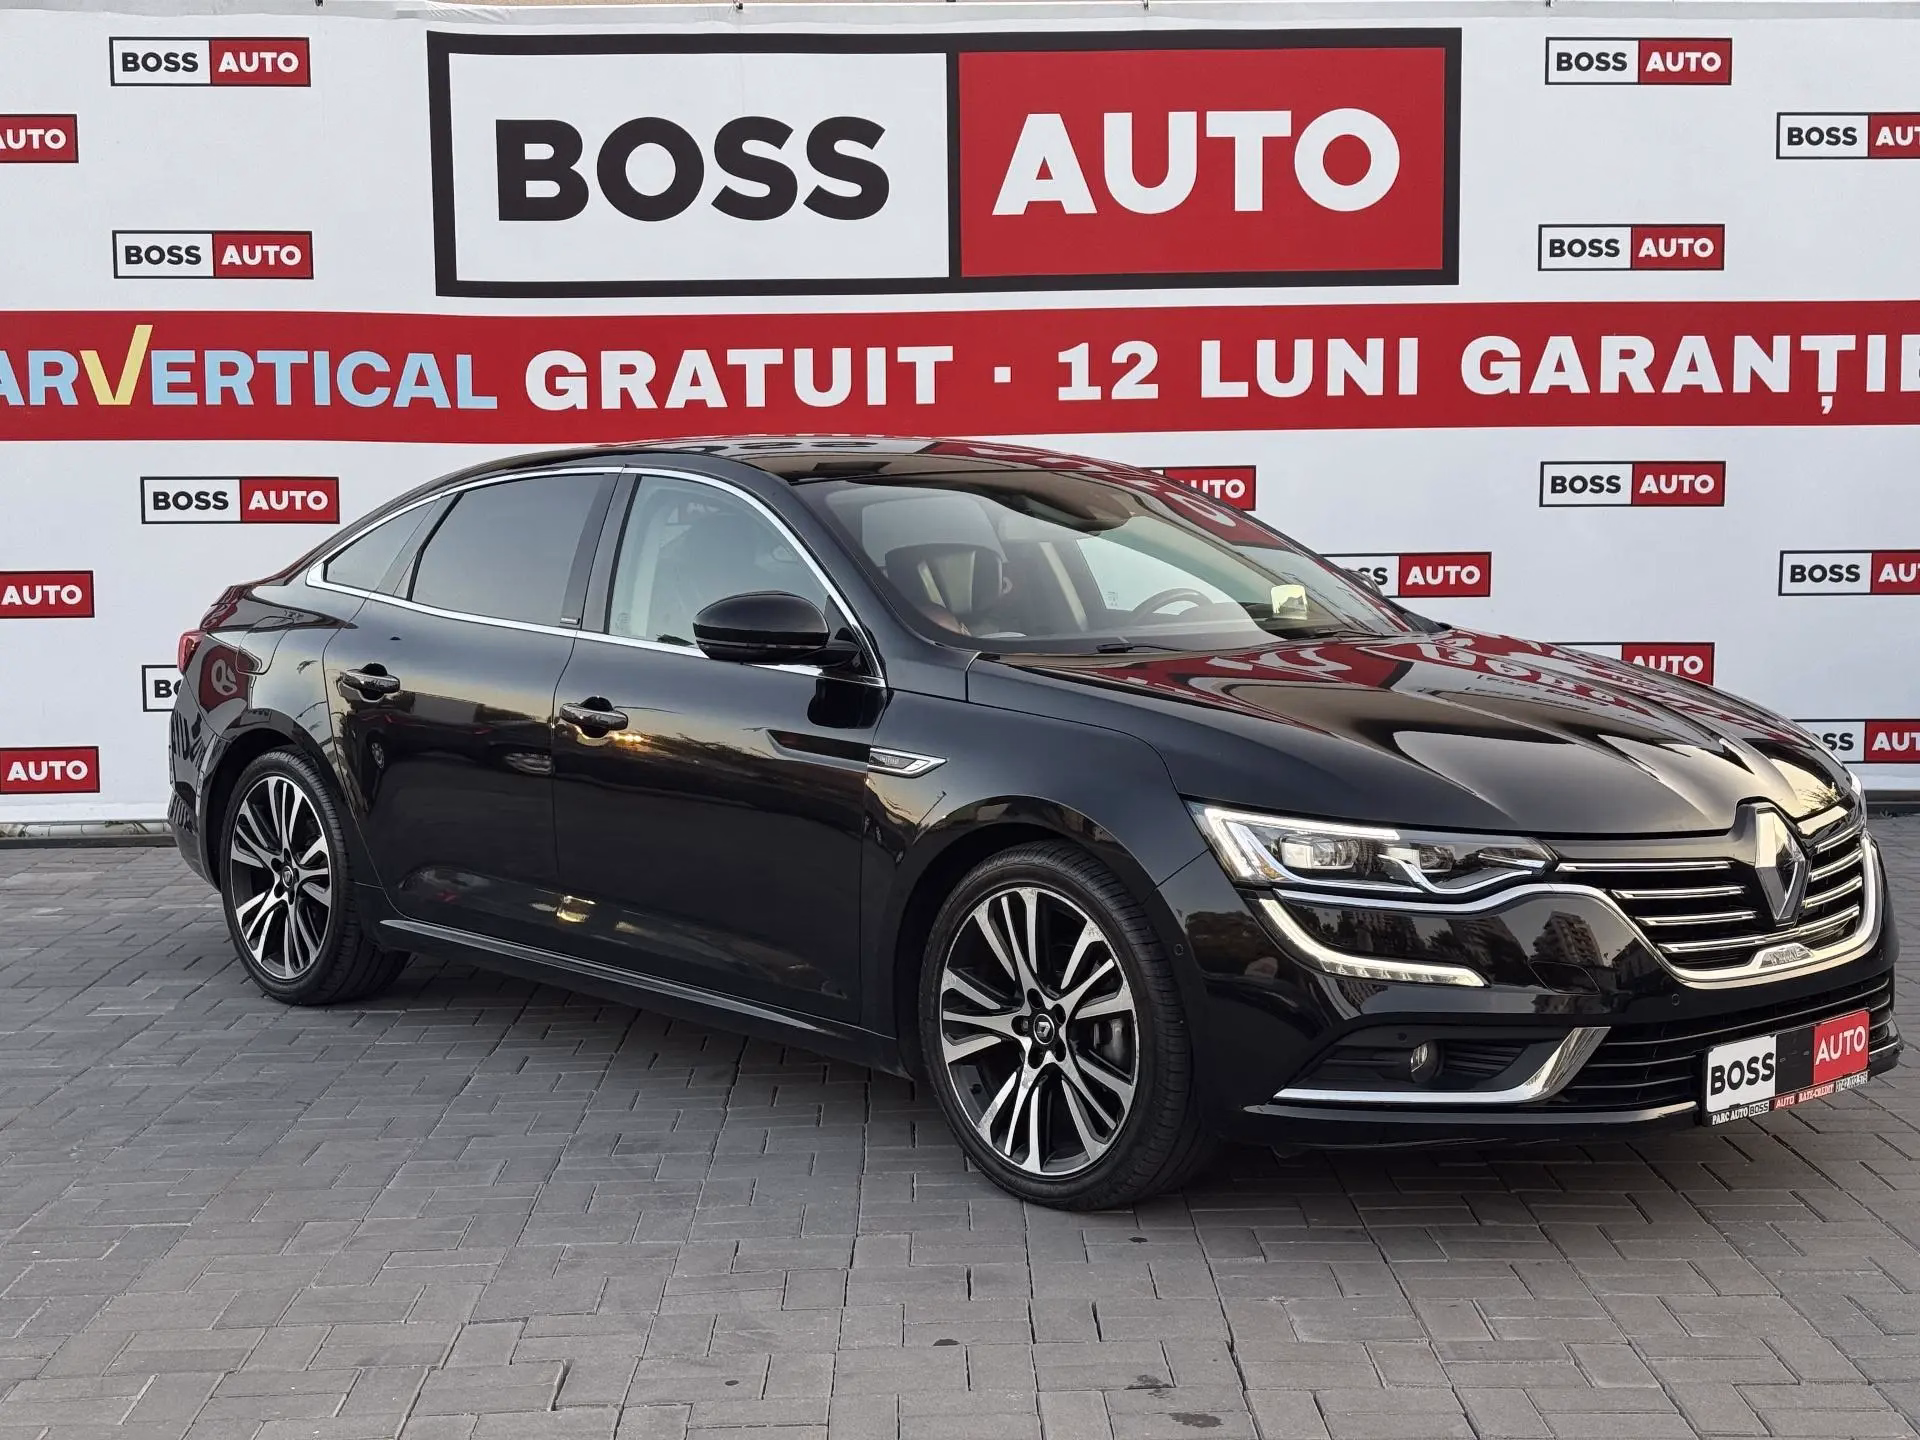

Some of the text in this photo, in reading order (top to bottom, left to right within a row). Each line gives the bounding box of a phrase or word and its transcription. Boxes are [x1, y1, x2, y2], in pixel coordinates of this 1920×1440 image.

[121, 51, 299, 73] BOSS AUTO
[1556, 51, 1722, 73] BOSS AUTO
[1787, 126, 1858, 146] BOSS
[495, 107, 1401, 222] BOSS AUTO
[124, 244, 302, 266] BOSS AUTO
[1549, 237, 1715, 258] BOSS AUTO
[525, 345, 954, 411] GRATUIT
[1057, 340, 1159, 401] 12
[1200, 337, 1419, 399] LUNI
[1180, 479, 1246, 499] TO
[1550, 474, 1715, 494] BOSS AUTO
[152, 490, 329, 511] BOSS AUTO
[1405, 565, 1481, 586] AUTO
[1789, 562, 1920, 583] BOSS AU
[1, 584, 83, 606] AUTO
[6, 759, 89, 782] AUTO
[1710, 1025, 1866, 1096] BOSS AUTO
[1712, 1112, 1730, 1125] PARC
[1730, 1107, 1749, 1121] AUTO
[1749, 1102, 1769, 1115] BOSS
